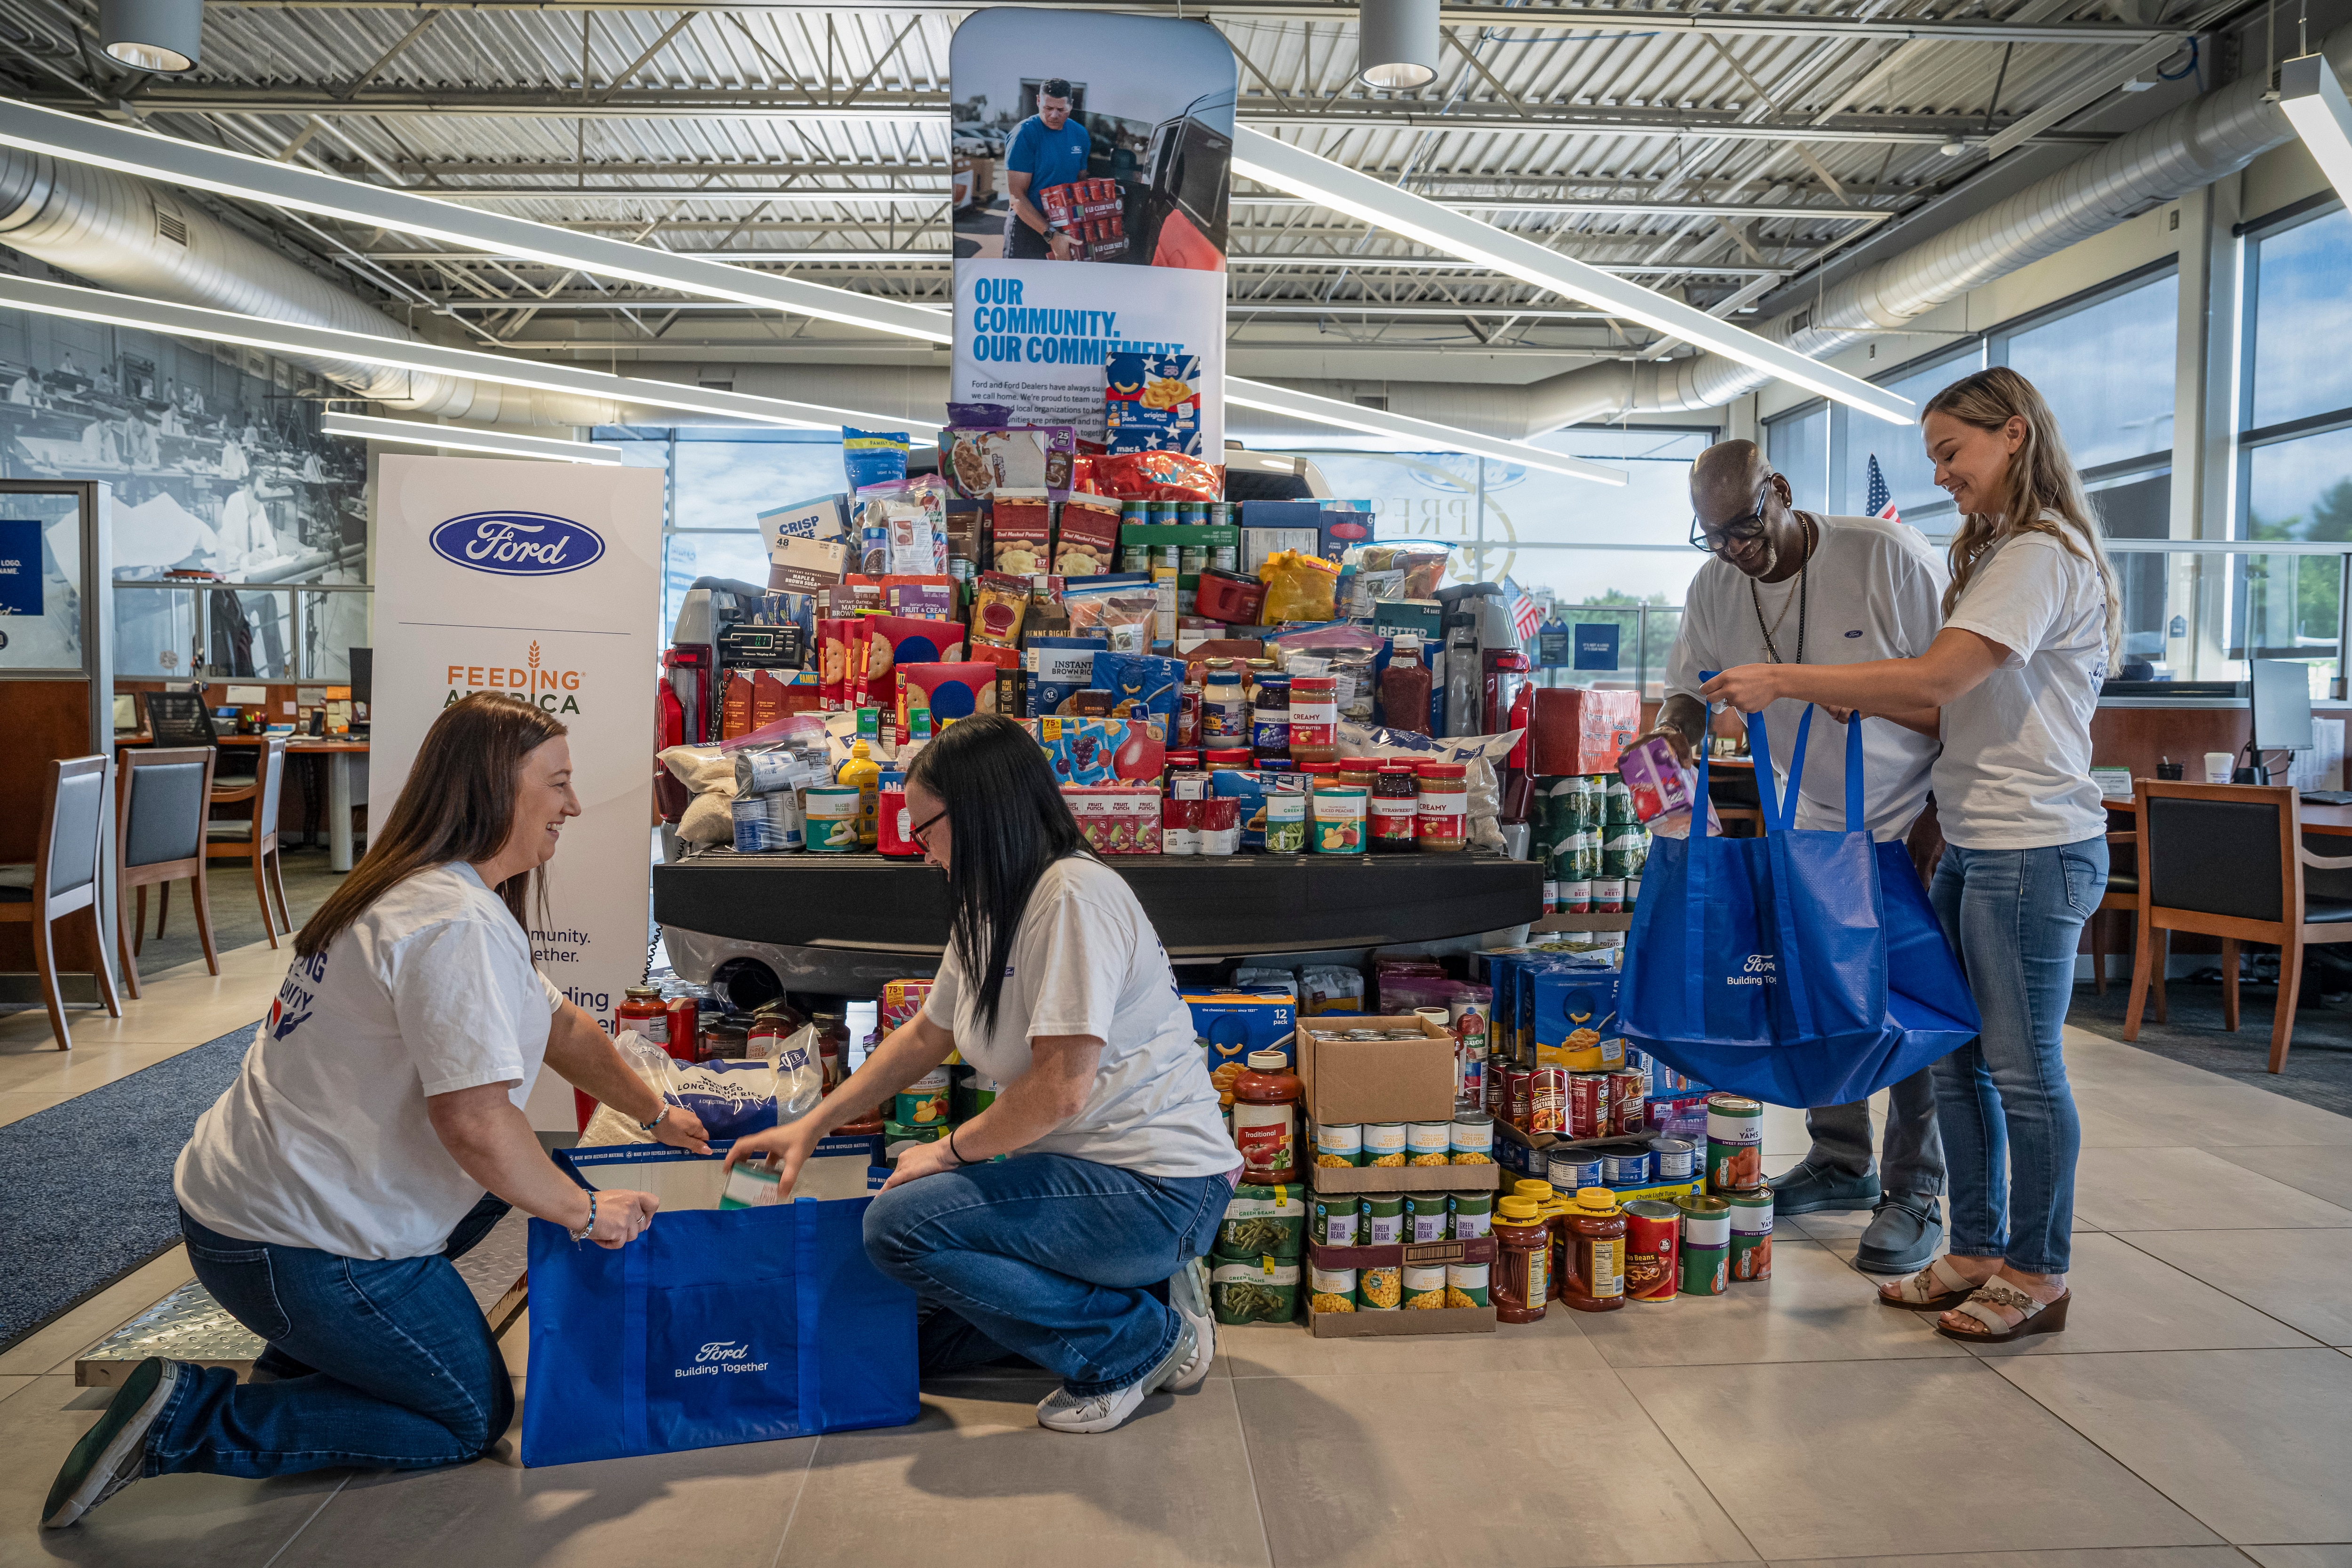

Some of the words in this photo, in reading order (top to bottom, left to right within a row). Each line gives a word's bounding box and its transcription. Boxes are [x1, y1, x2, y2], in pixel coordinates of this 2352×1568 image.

[975, 278, 1023, 305] OUR
[974, 307, 1120, 337] COMMUNITY.
[973, 335, 1022, 362] OUR
[1067, 384, 1090, 393] always
[1034, 406, 1081, 414] organizations
[1044, 417, 1076, 427] prepared
[779, 516, 819, 534] CRISP
[1367, 515, 1374, 524] 6
[465, 520, 570, 565] Ford
[1091, 537, 1110, 546] Potatoes
[1378, 627, 1428, 638] BETTER
[1162, 660, 1171, 671] 5
[799, 674, 818, 684] FAMILY
[897, 672, 906, 685] RITZ
[1617, 734, 1622, 745] 6
[531, 928, 591, 946] munity.
[534, 948, 579, 963] ether.
[1608, 953, 1613, 962] 8
[1743, 955, 1775, 972] For
[1727, 976, 1762, 986] Building
[1274, 1009, 1287, 1019] 12
[1532, 1101, 1557, 1111] VEGETABLE
[1331, 1223, 1345, 1232] GREEN
[1459, 1221, 1473, 1230] GREEN
[695, 1341, 748, 1362] Ford
[675, 1365, 718, 1377] Building
[722, 1362, 768, 1373] Together
